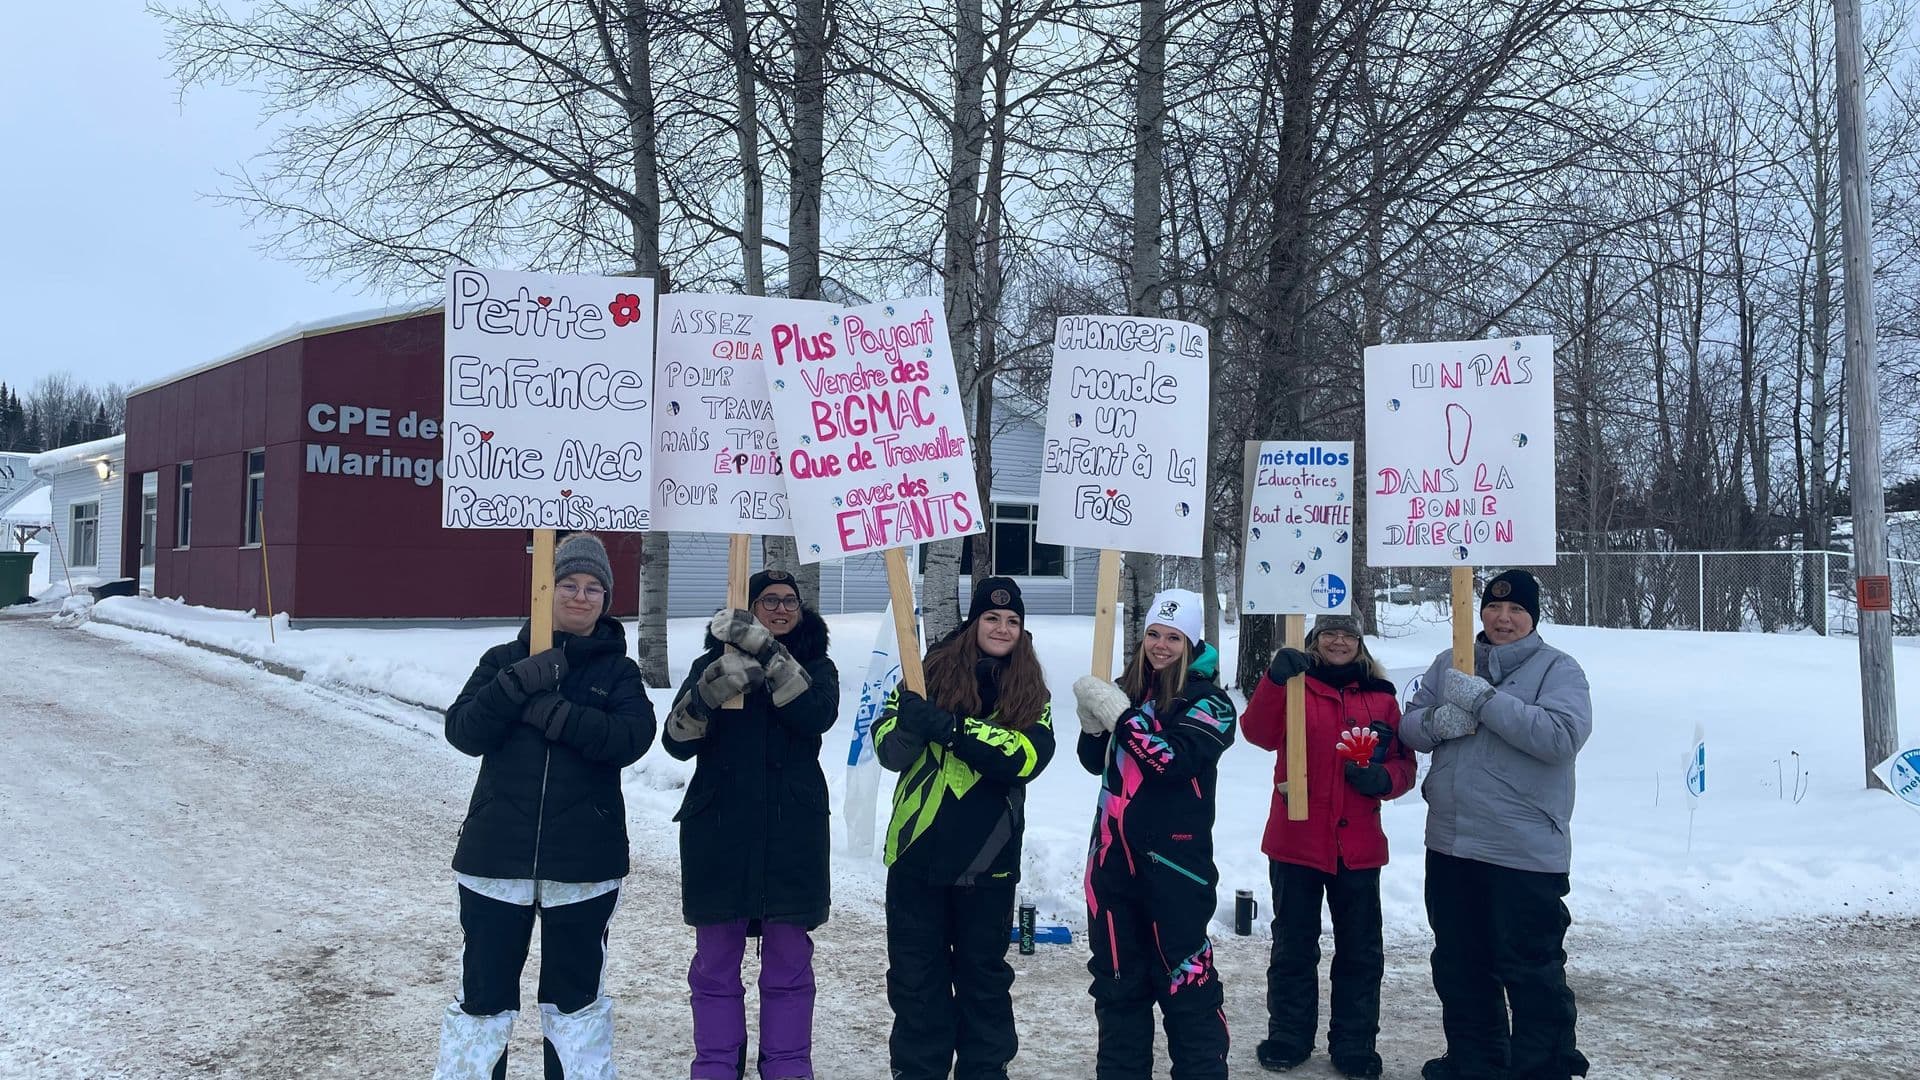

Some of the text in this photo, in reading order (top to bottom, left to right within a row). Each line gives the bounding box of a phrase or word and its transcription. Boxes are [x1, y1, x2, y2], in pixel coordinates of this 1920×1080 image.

[453, 270, 606, 339] Petite
[671, 309, 754, 336] ASSEZ
[771, 309, 934, 365] Plus Payant
[713, 340, 763, 360] QUA
[1180, 324, 1203, 358] Le
[665, 361, 734, 387] POUR
[801, 359, 929, 397] Vendre des
[308, 403, 444, 440] CPE de
[701, 396, 774, 421] TRAVA
[790, 426, 966, 479] Que de Travailler
[1132, 443, 1152, 479] à
[1168, 449, 1196, 487] La
[1259, 447, 1350, 466] métallos
[658, 478, 718, 507] POUR
[846, 473, 930, 507] avec des
[1294, 487, 1303, 499] à
[1376, 462, 1514, 495] DANS LA
[447, 486, 650, 530] Reconaissance
[836, 491, 973, 552] ENFANTS
[1253, 504, 1352, 526] Bout de SOUFFLE
[1407, 495, 1497, 519] BONNE
[1127, 739, 1147, 759] RIDE
